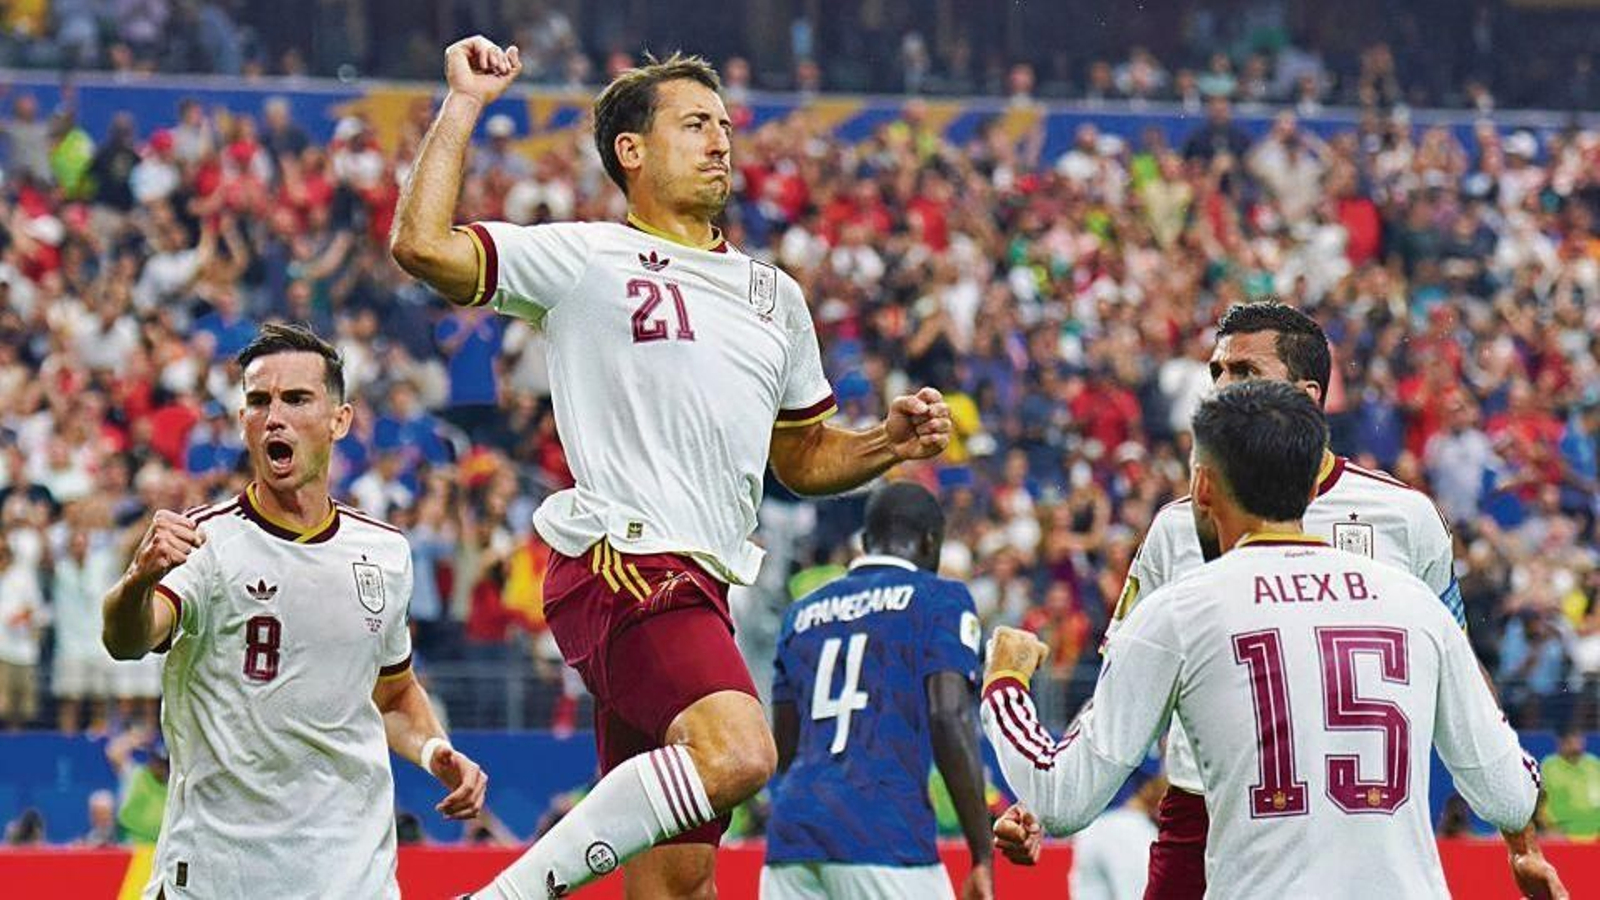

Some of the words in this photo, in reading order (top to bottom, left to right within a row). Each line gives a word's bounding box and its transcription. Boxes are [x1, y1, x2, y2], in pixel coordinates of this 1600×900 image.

[626, 278, 696, 343] 21
[794, 585, 915, 633] UPAMECANO
[1254, 573, 1338, 604] ALEX
[1343, 572, 1378, 601] B.
[243, 615, 282, 683] 8
[812, 633, 868, 754] 4
[1231, 626, 1412, 819] 15
